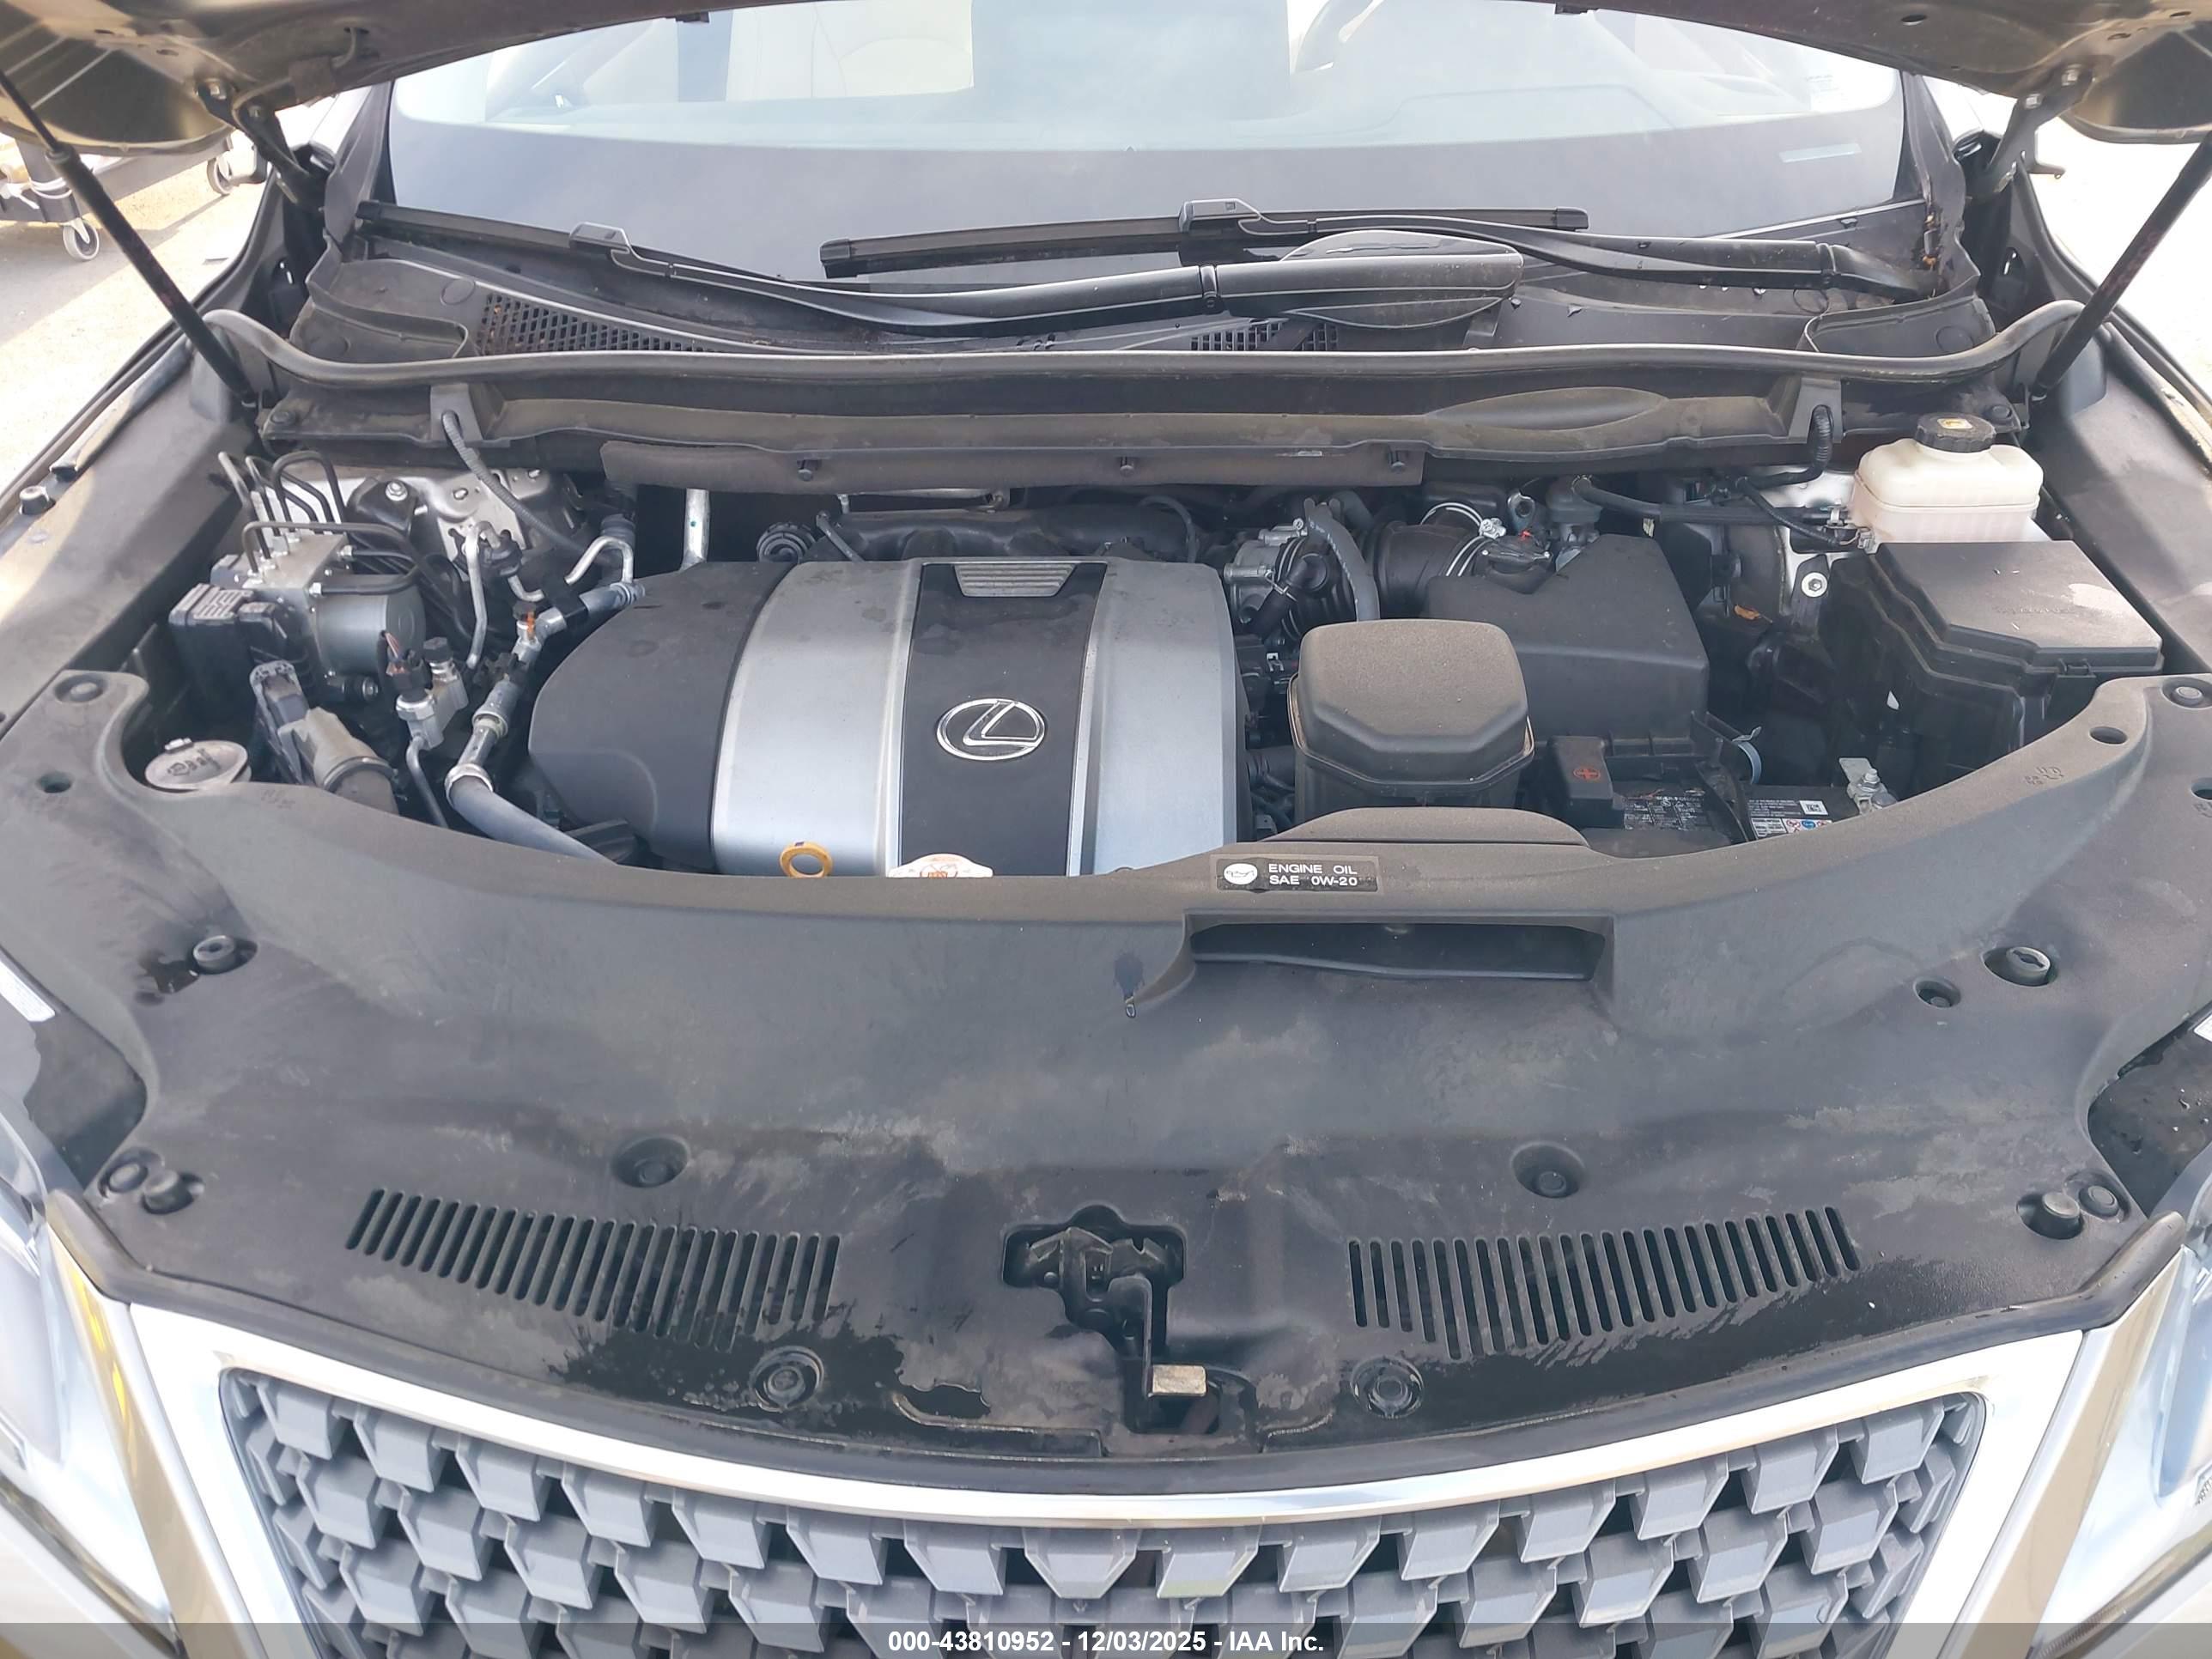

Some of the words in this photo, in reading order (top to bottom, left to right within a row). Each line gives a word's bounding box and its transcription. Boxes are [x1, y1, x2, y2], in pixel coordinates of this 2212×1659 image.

[1268, 863, 1323, 874] ENGINE
[1333, 865, 1358, 875] OIL
[1269, 875, 1300, 885] SAE
[1310, 876, 1358, 886] 0W-20
